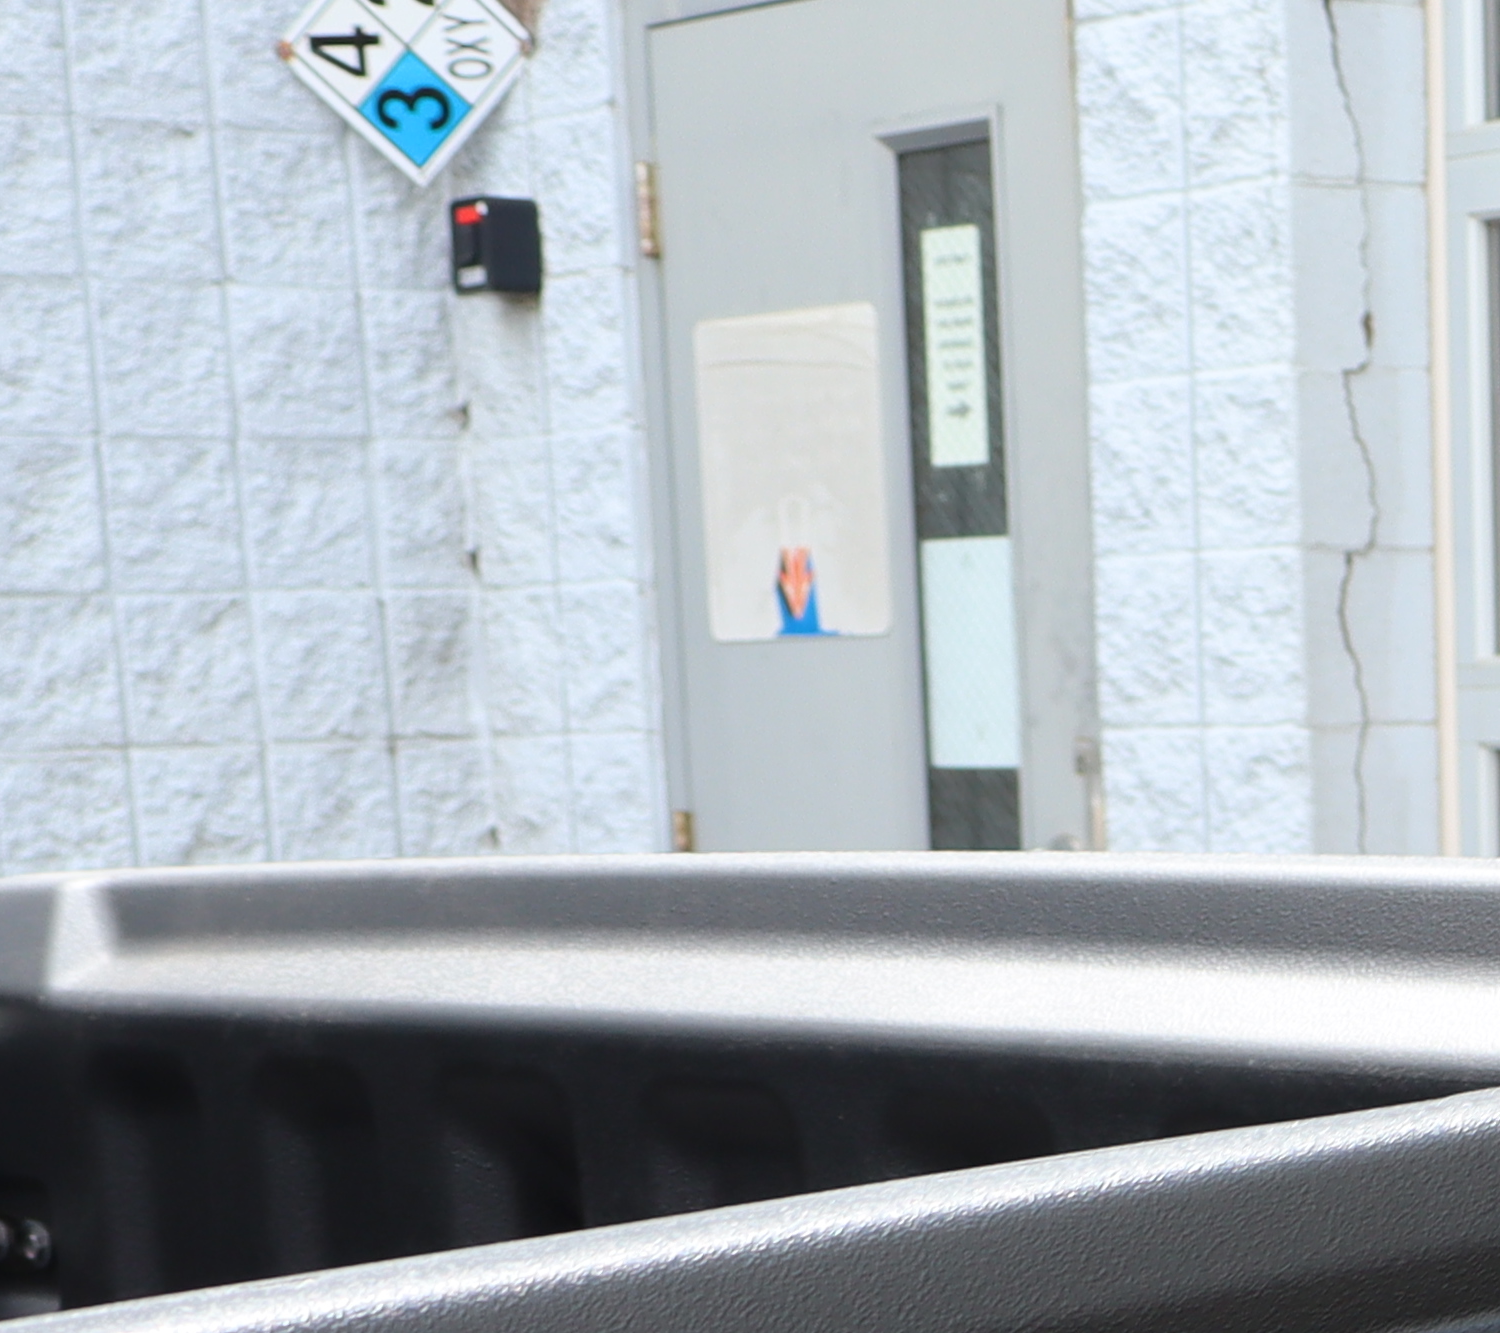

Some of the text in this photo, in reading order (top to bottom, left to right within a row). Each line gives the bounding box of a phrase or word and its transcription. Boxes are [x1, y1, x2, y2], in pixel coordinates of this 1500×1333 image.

[310, 25, 380, 77] 4
[442, 13, 493, 79] OXY
[376, 87, 449, 130] 3
